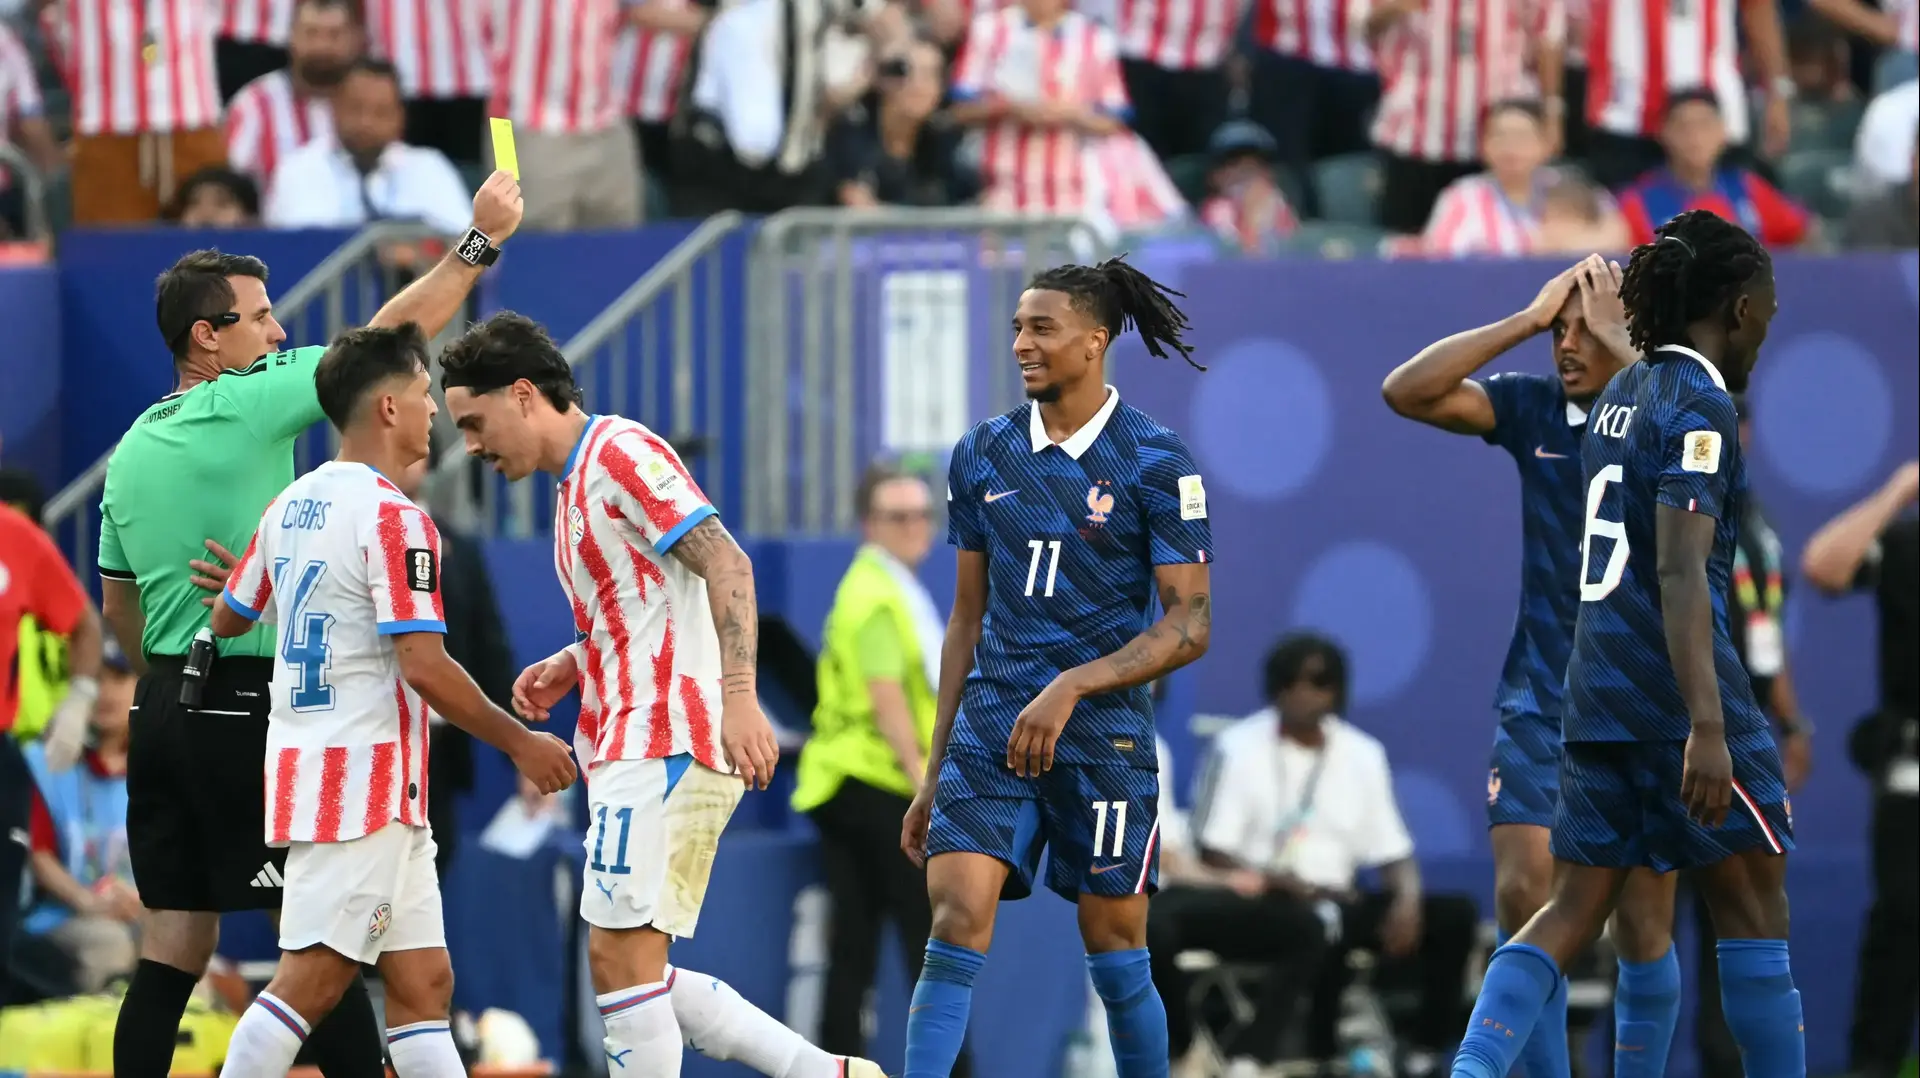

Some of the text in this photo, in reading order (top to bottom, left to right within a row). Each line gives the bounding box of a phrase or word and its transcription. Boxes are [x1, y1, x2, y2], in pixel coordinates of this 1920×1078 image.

[142, 402, 184, 424] NTASHEV
[1580, 464, 1631, 602] 6
[1024, 540, 1062, 597] 11
[591, 806, 634, 875] 11
[1092, 801, 1128, 857] 11
